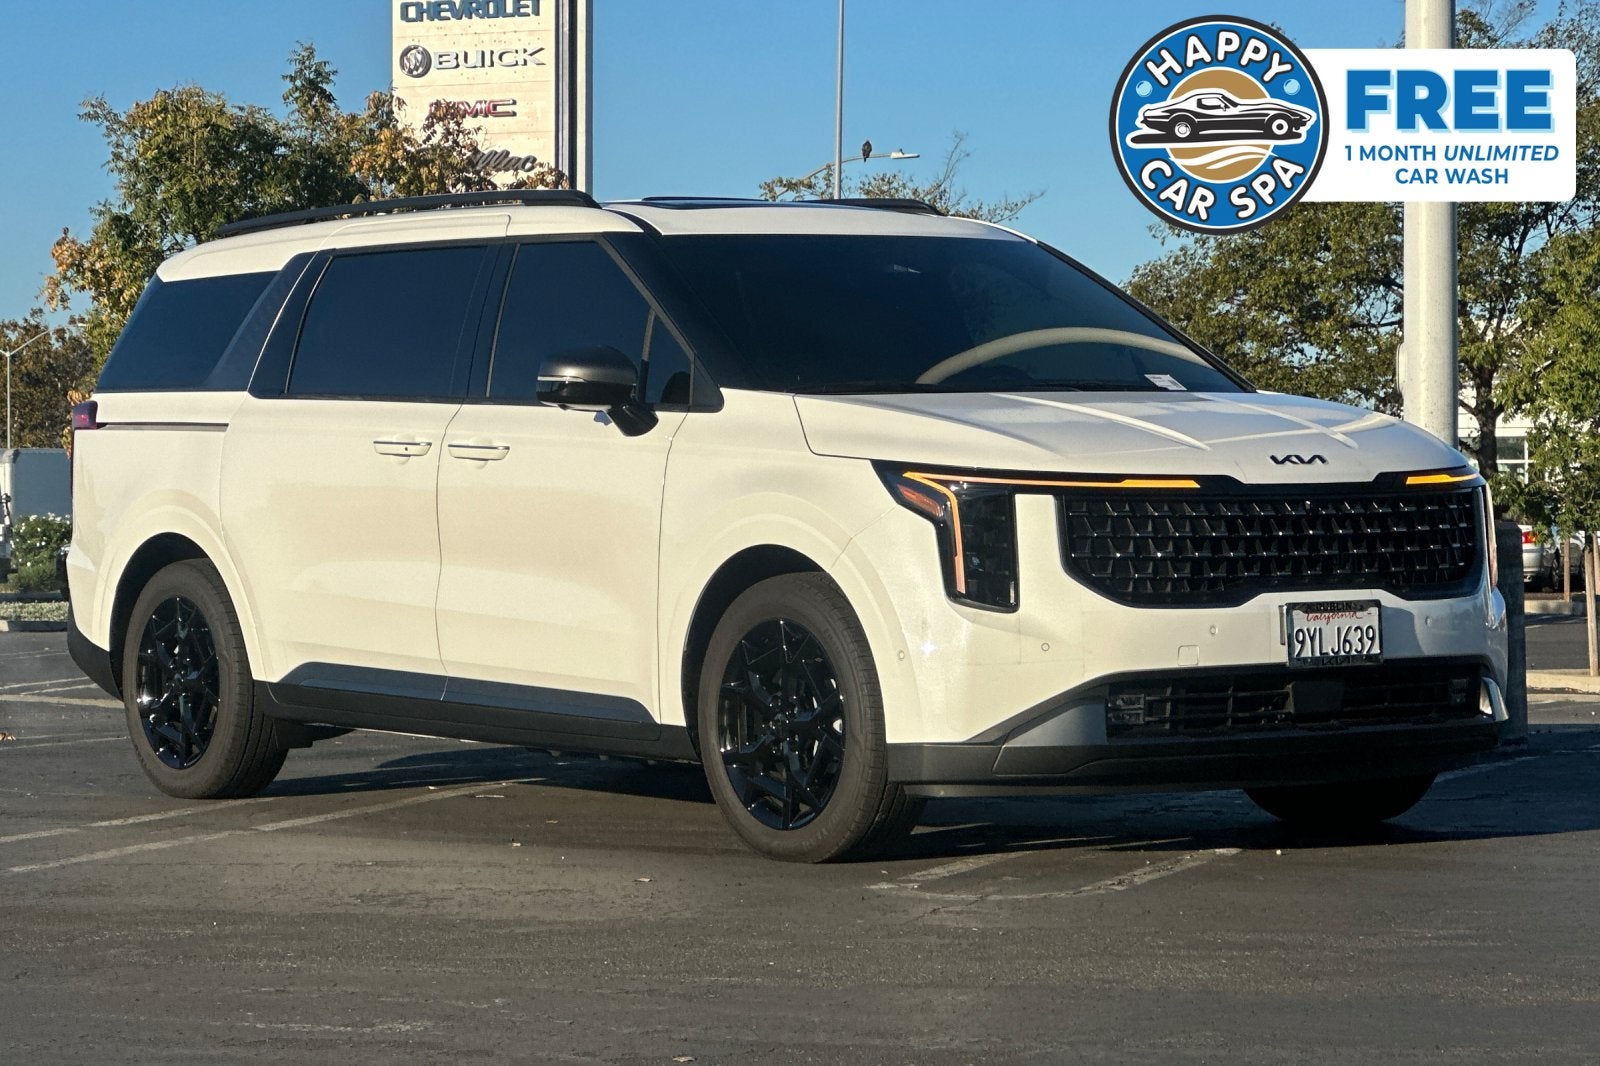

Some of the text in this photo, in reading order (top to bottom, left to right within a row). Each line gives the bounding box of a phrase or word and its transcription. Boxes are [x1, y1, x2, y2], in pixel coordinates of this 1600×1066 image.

[400, 0, 540, 22] CHEVROLET
[433, 47, 547, 70] BUICK
[1294, 625, 1376, 657] 9YLJ639
